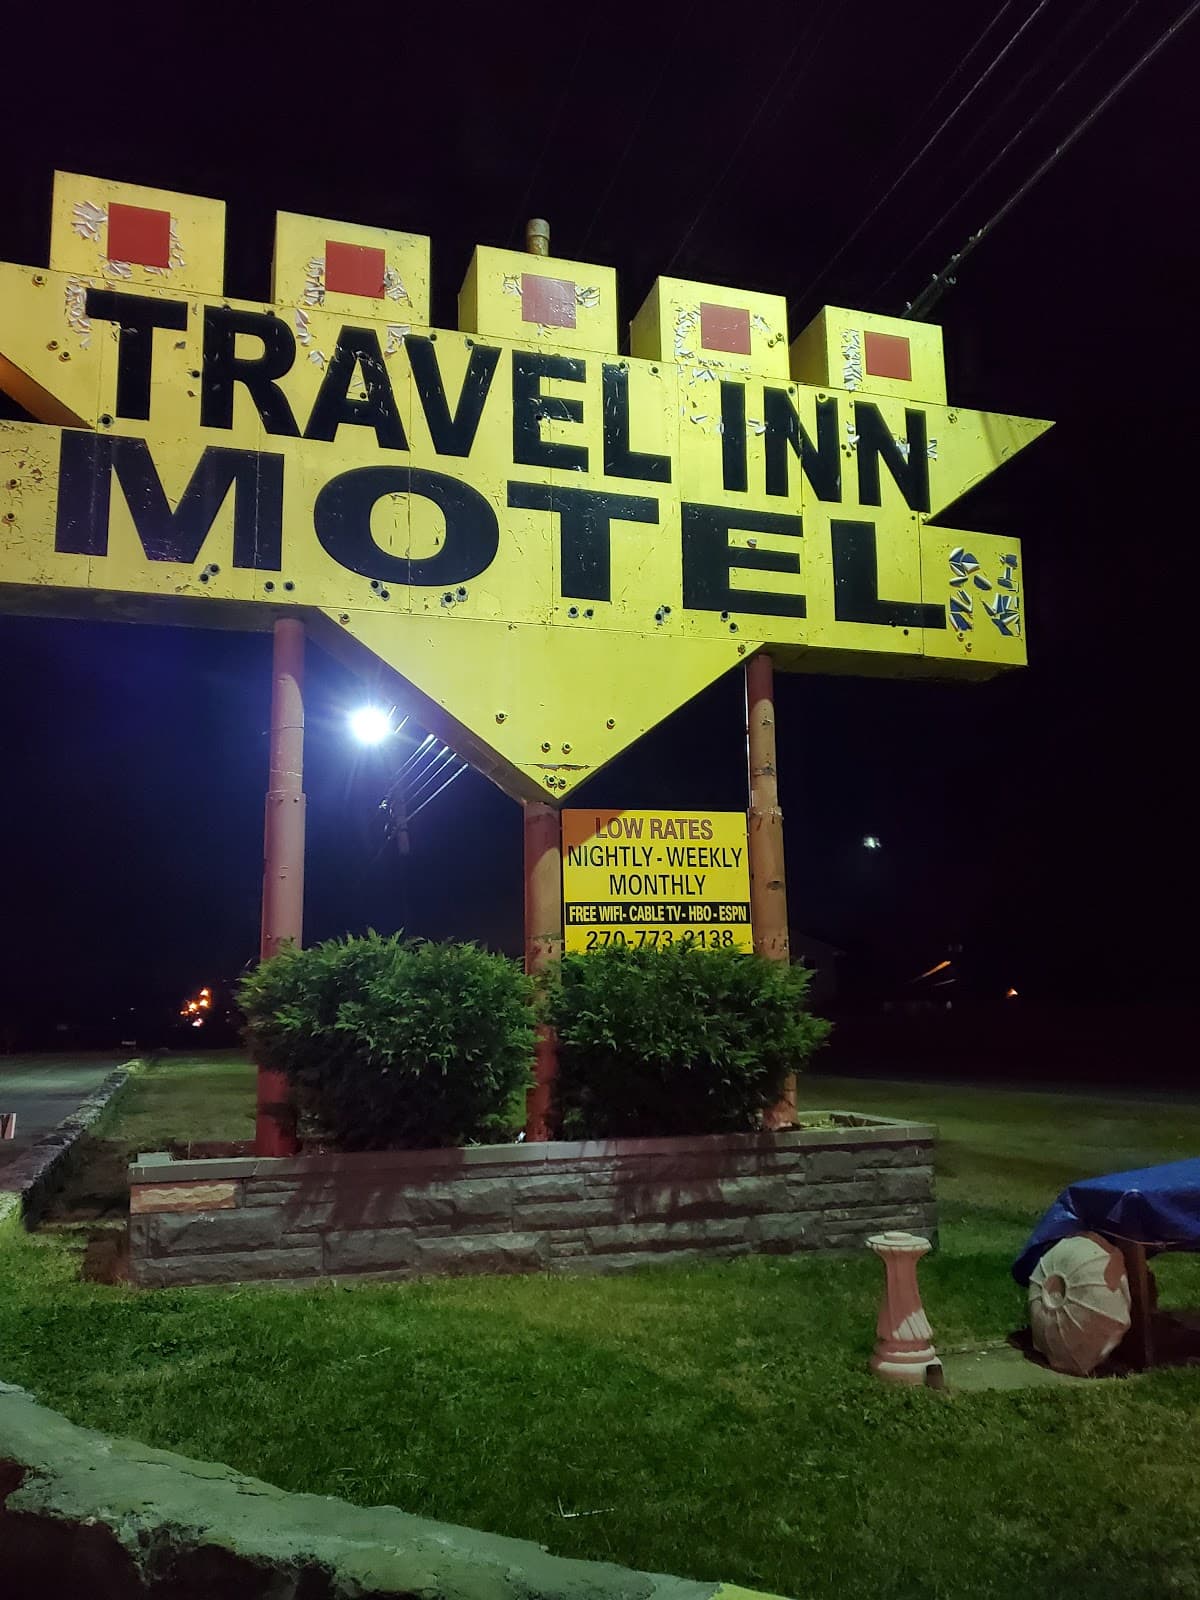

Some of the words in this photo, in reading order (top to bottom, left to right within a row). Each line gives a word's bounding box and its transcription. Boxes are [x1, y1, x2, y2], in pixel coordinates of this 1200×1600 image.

[85, 287, 672, 484] TRAVEL
[720, 379, 931, 514] INN
[55, 428, 947, 630] MOTEL
[595, 817, 644, 839] LOW
[650, 819, 714, 841] RATES
[568, 845, 653, 867] NIGHTLY
[666, 846, 742, 868] WEEKLY
[609, 874, 706, 896] MONTHLY
[569, 905, 597, 921] FREE
[629, 904, 665, 922] CABLE
[719, 905, 747, 922] ESPN
[586, 929, 734, 950] 270-7732138
